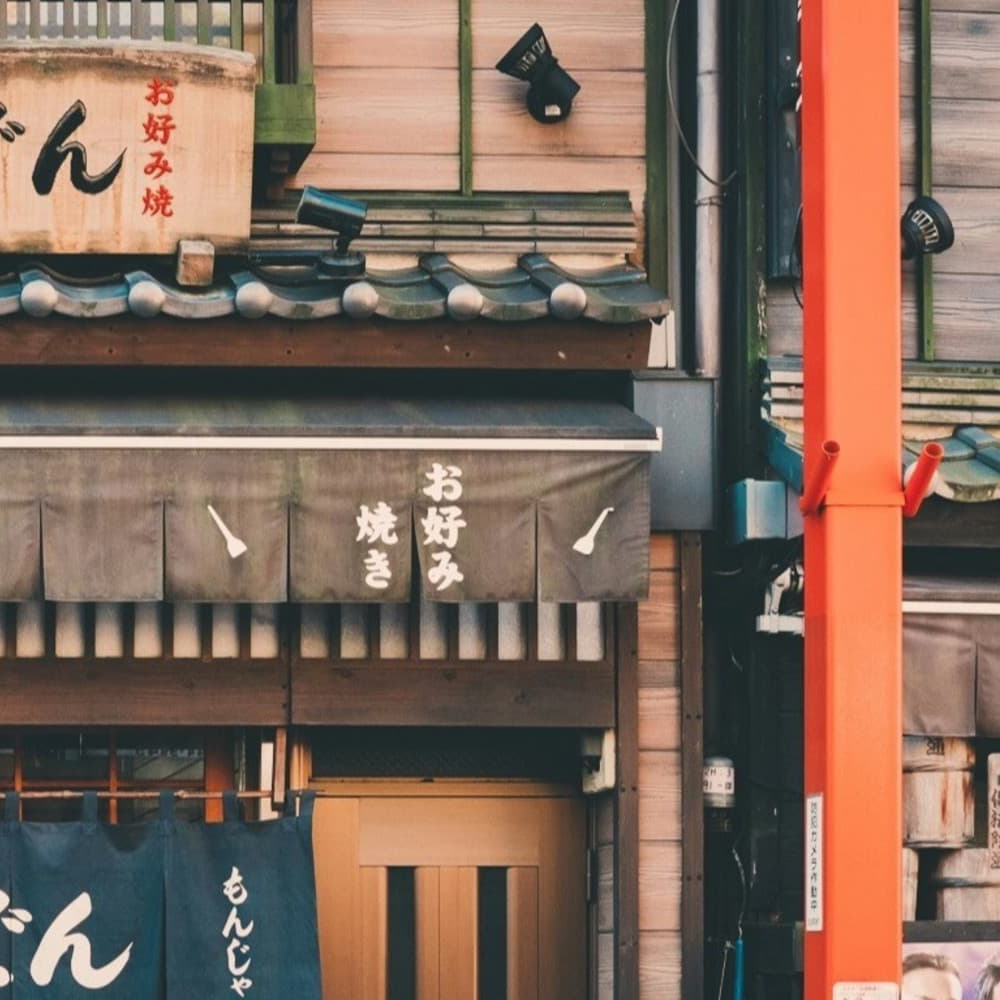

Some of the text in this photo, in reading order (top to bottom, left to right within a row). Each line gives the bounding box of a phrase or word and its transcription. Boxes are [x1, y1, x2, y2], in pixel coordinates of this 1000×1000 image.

[141, 77, 177, 218] お好み焼
[355, 501, 399, 590] 焼き
[421, 462, 466, 592] お好み
[222, 866, 254, 998] もんじゃ
